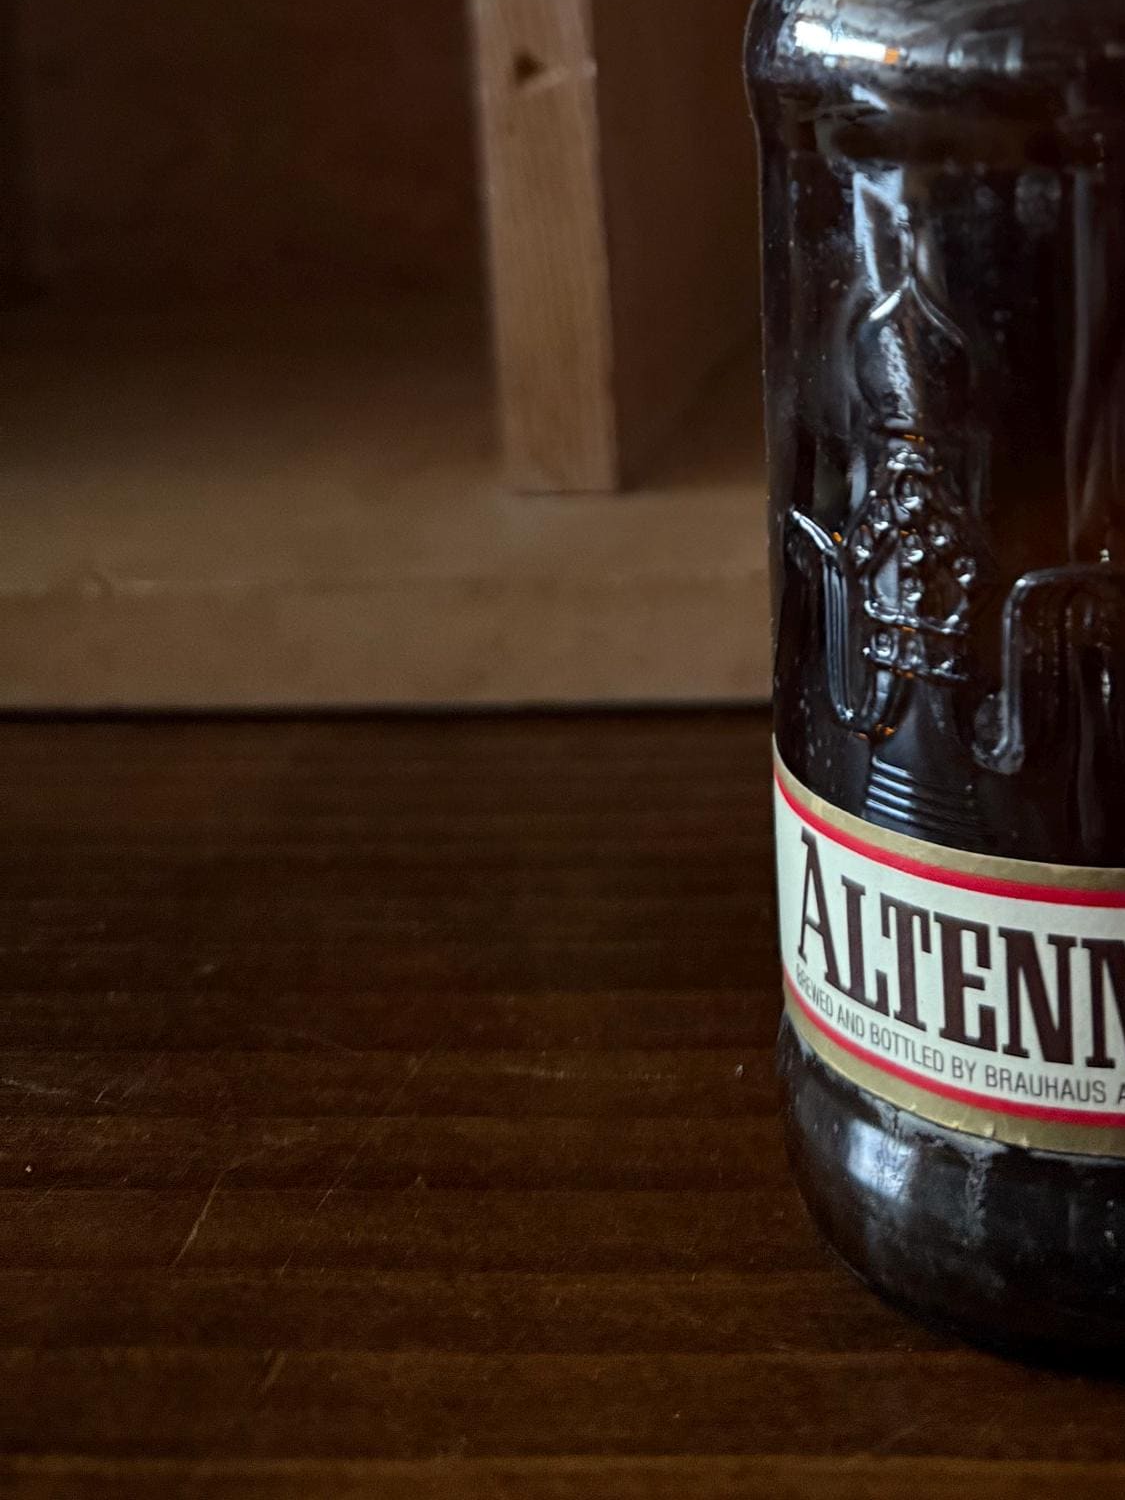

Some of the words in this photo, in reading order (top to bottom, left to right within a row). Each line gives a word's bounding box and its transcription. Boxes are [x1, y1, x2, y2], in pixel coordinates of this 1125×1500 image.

[796, 962, 834, 1018] BREWED
[837, 1004, 865, 1039] AND
[869, 1022, 945, 1074] BOTTLED
[951, 1055, 977, 1084] BY
[985, 1064, 1106, 1104] BRAUHAUS
